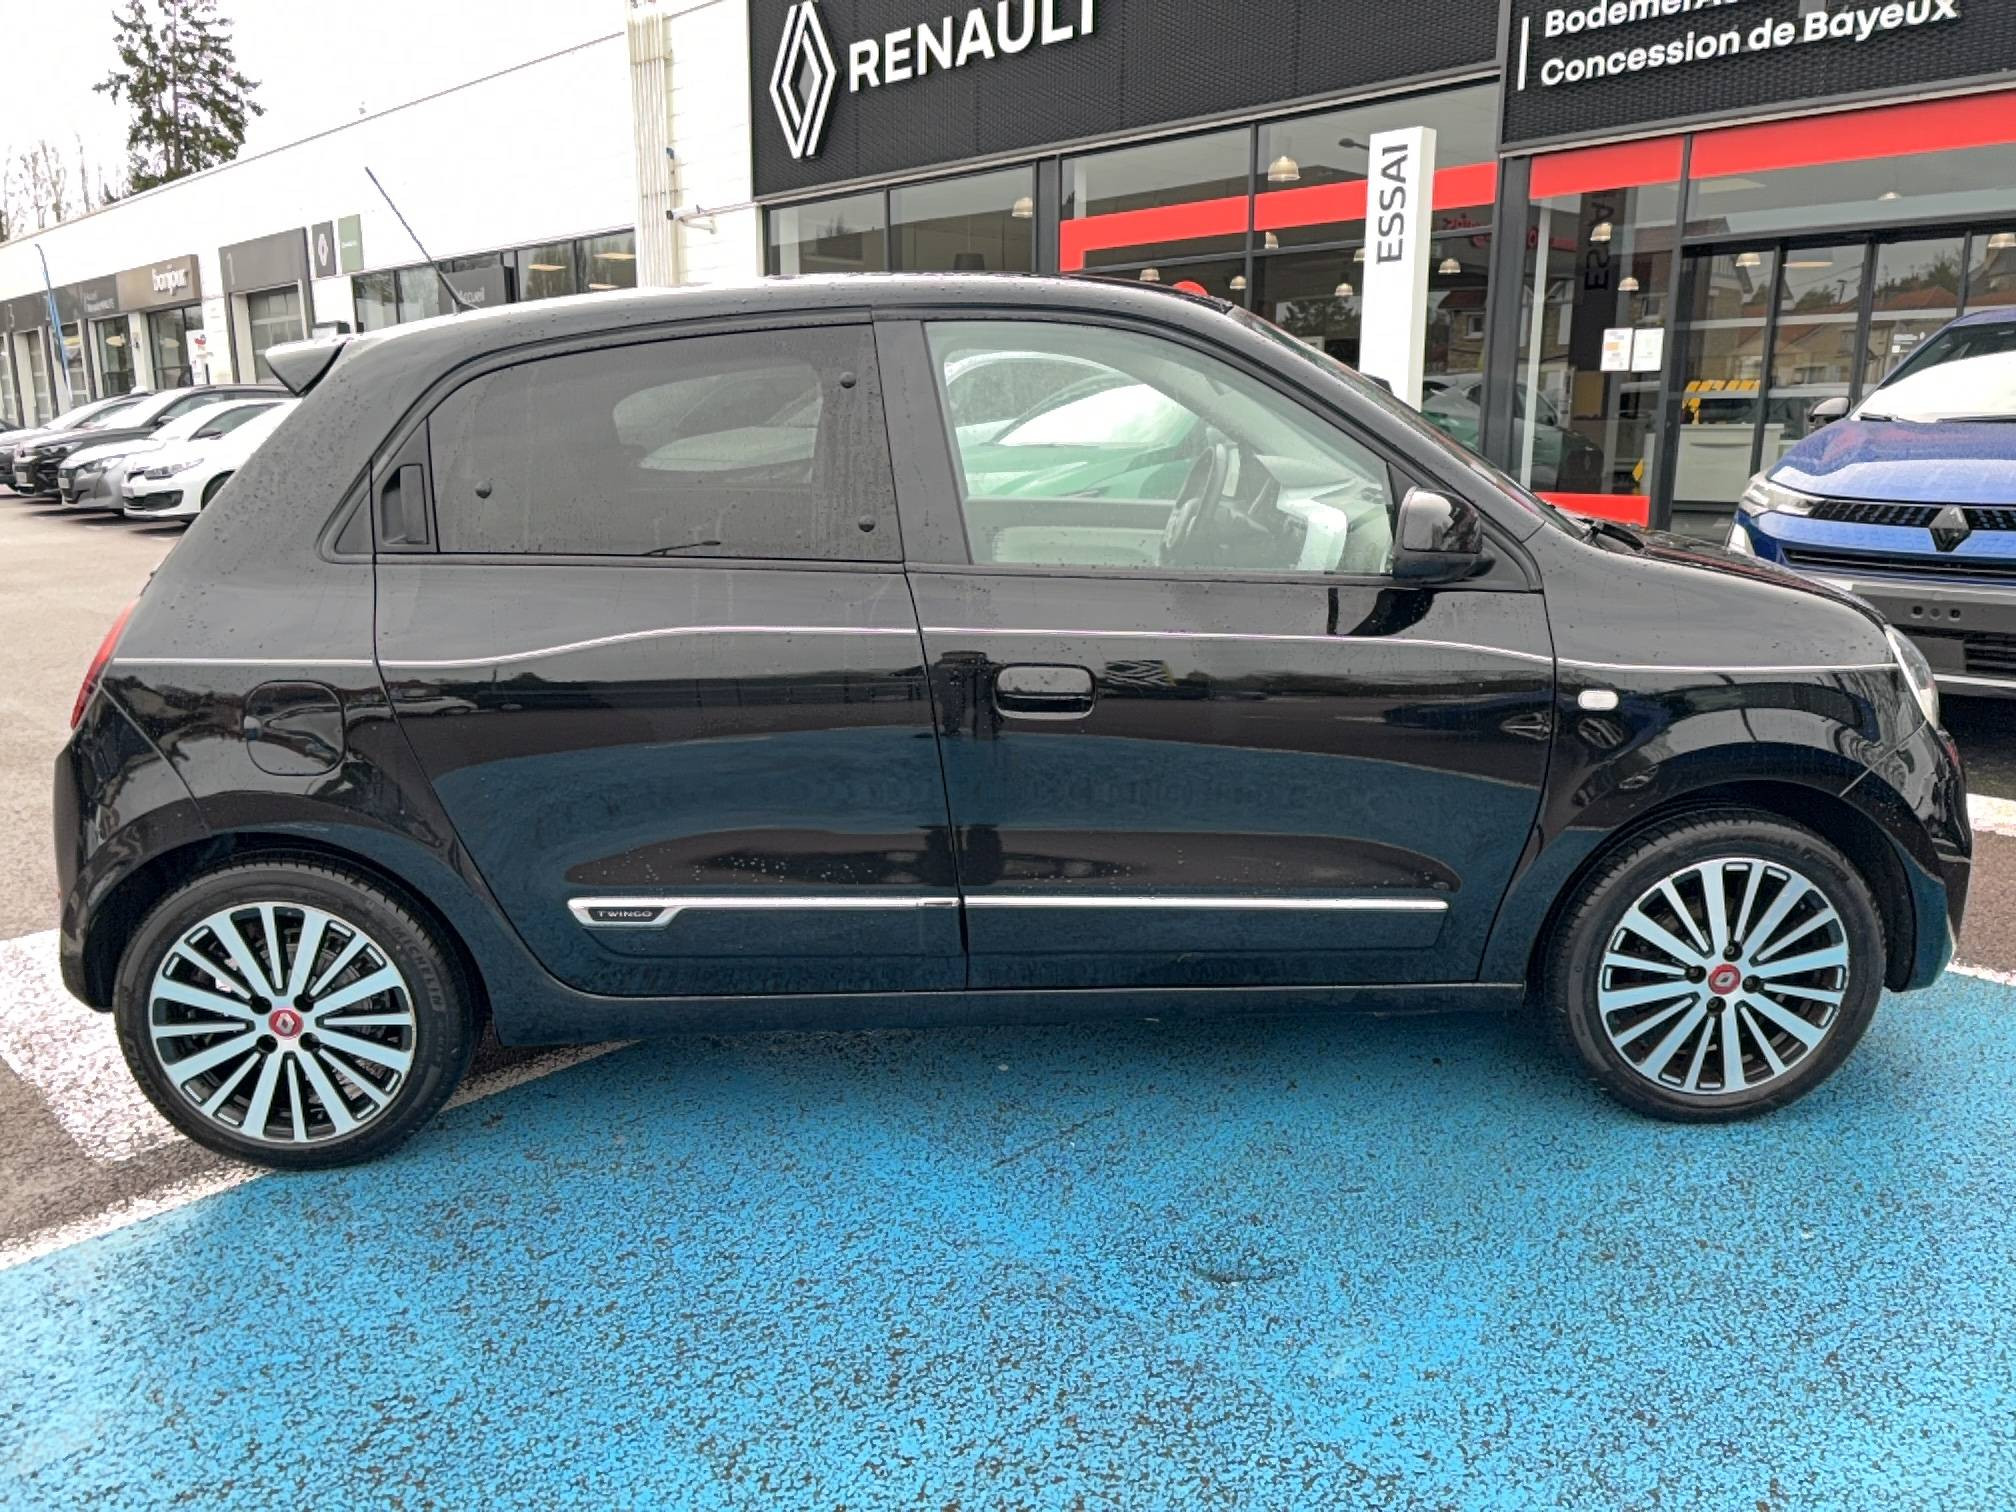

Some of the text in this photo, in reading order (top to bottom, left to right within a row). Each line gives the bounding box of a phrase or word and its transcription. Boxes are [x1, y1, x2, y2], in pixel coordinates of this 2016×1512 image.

[1540, 0, 1958, 86] Concession de Bayeux
[1376, 144, 1408, 264] ESSAI
[597, 910, 654, 918] TWINGO
